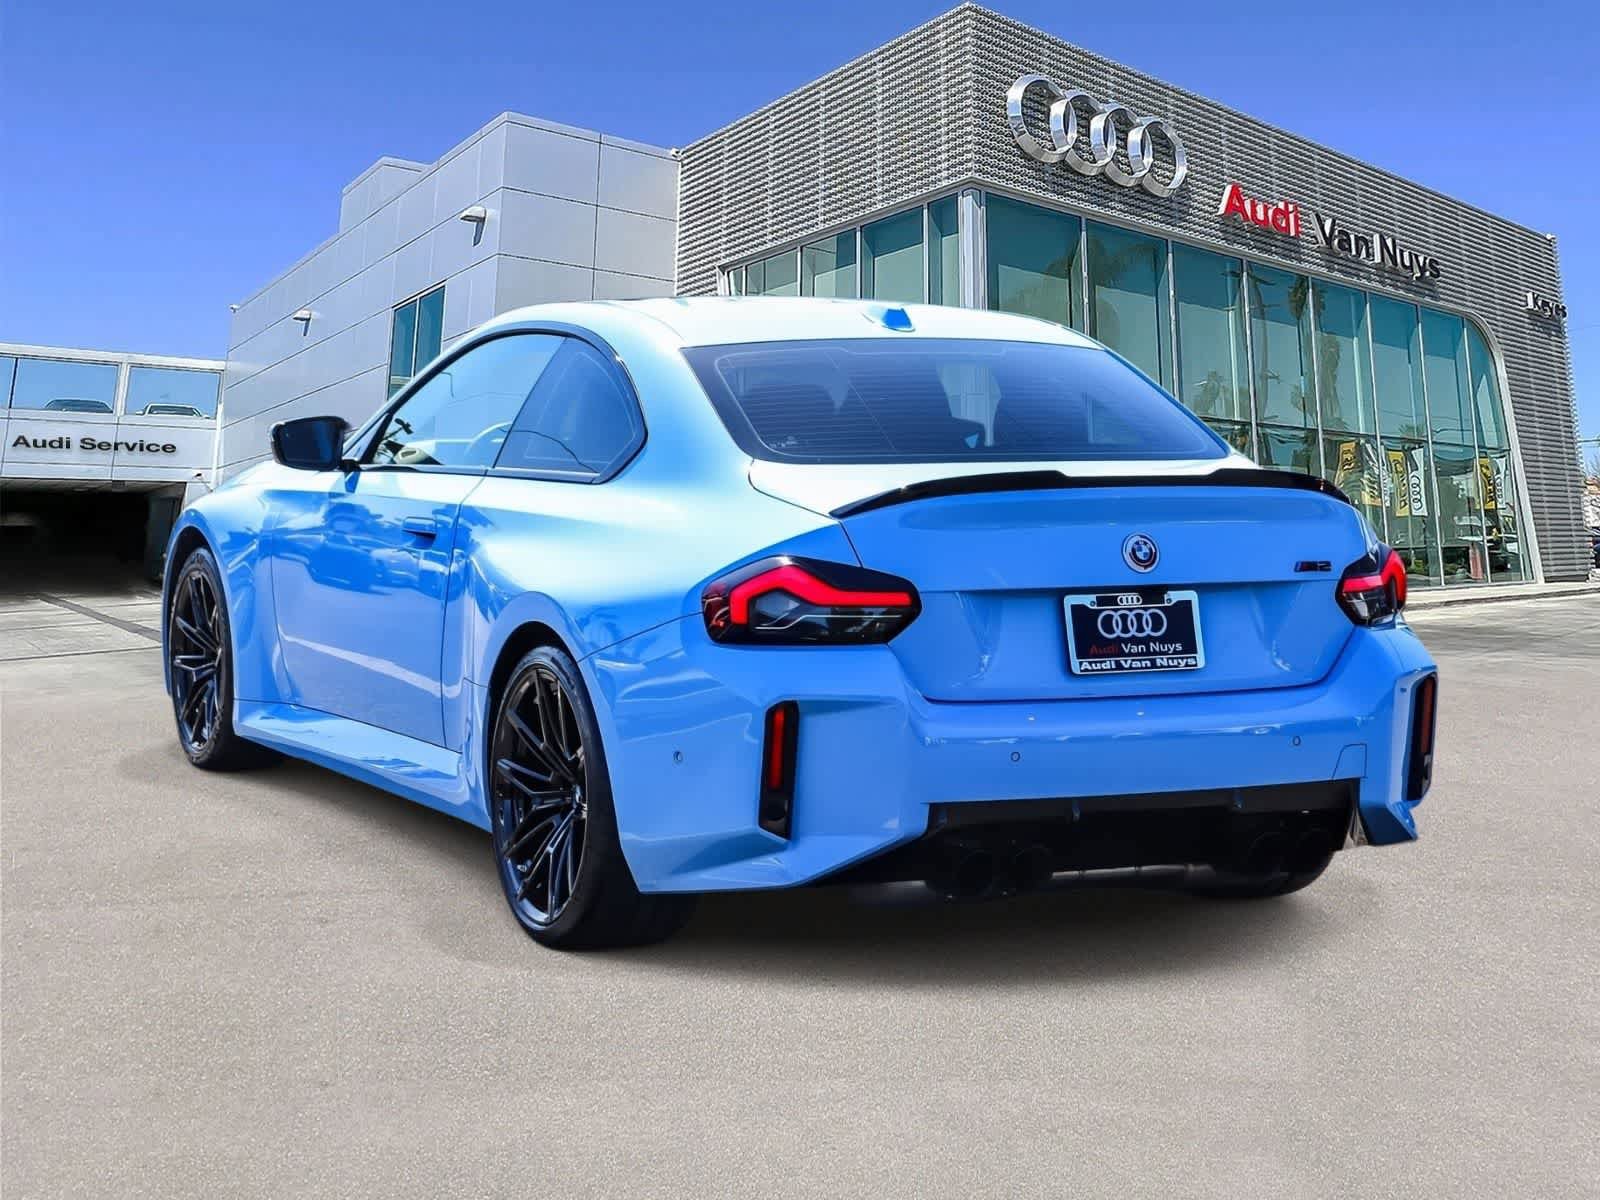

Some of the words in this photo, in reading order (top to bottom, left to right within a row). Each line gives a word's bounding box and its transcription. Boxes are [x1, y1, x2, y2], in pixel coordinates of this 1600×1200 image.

[1218, 183, 1302, 237] Audi
[1311, 212, 1372, 258] Van
[1373, 232, 1441, 280] Nuys
[1526, 291, 1567, 319] Keyes
[12, 434, 72, 450] Audi
[79, 437, 177, 454] Service
[1089, 643, 1119, 655] Audi
[1121, 642, 1147, 654] Van
[1149, 641, 1183, 654] Nuys
[1080, 659, 1116, 671] Audi
[1120, 658, 1152, 669] Van
[1155, 656, 1197, 668] Nuys
